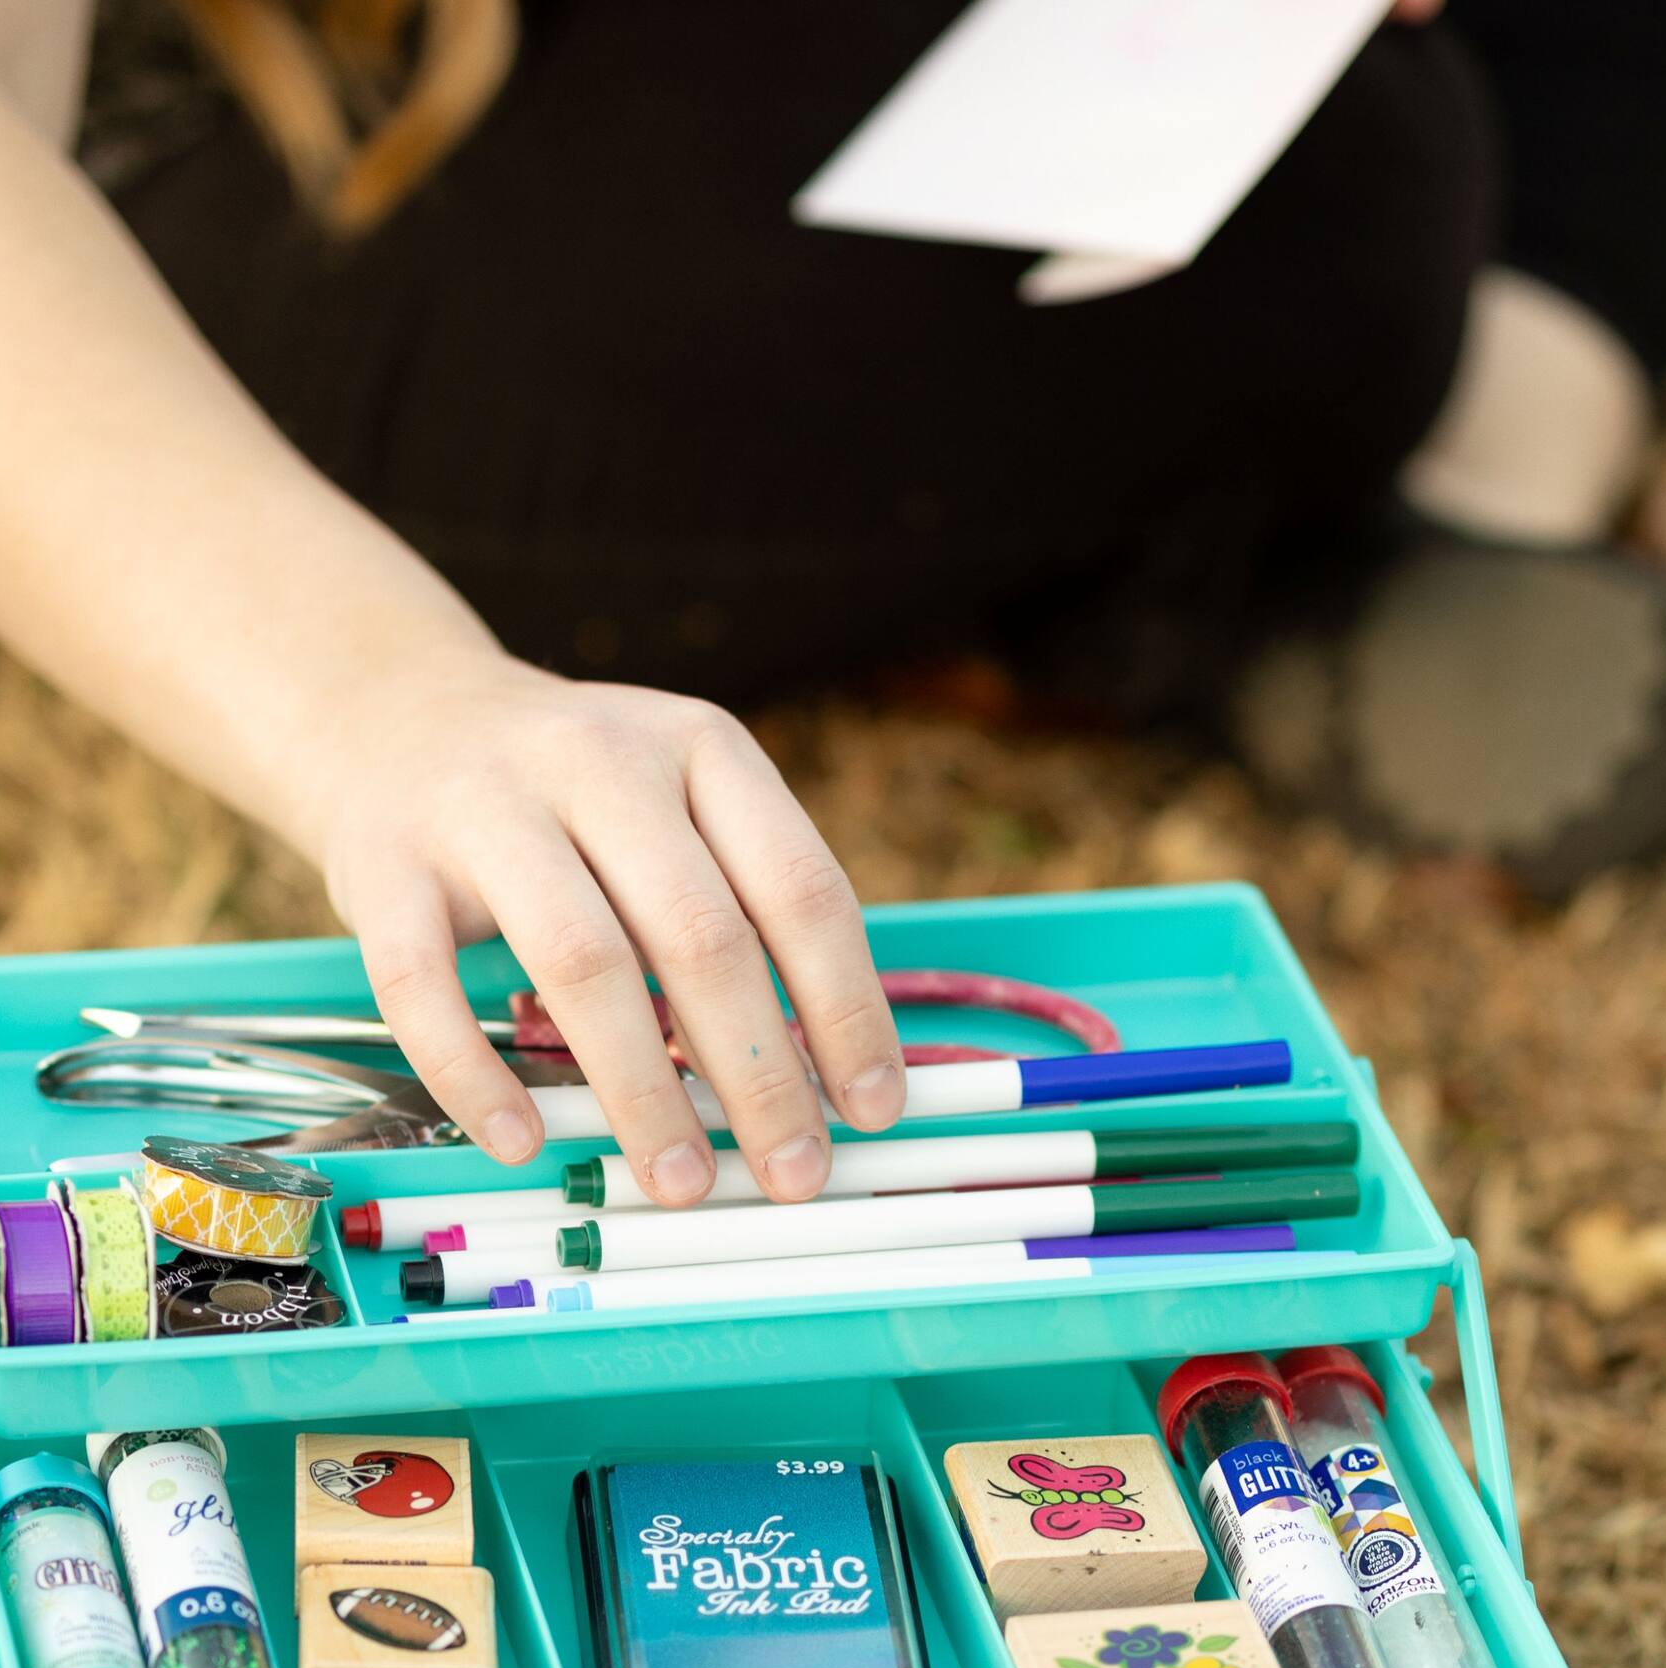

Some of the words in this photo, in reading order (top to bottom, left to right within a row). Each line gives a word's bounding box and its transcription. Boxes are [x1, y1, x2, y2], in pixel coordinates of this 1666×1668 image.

[219, 1284, 311, 1326] ribbon
[776, 1459, 845, 1476] $3.99
[1233, 1449, 1284, 1471] black
[1348, 1454, 1375, 1470] 4+
[1238, 1465, 1318, 1500] GLITTE
[639, 1514, 795, 1560] Specialty
[1253, 1529, 1276, 1544] Net
[1279, 1521, 1303, 1531] Wt.
[1258, 1540, 1277, 1555] 0.6
[1279, 1536, 1294, 1544] oz
[1366, 1541, 1385, 1554] Visit
[1368, 1551, 1391, 1564] More
[35, 1557, 123, 1600] Glitt
[641, 1547, 868, 1590] Fabric
[179, 1591, 227, 1618] 0.6
[697, 1589, 779, 1615] Ink
[783, 1588, 872, 1615] Pad
[1371, 1589, 1406, 1618] ROUP
[1409, 1584, 1438, 1593] USA
